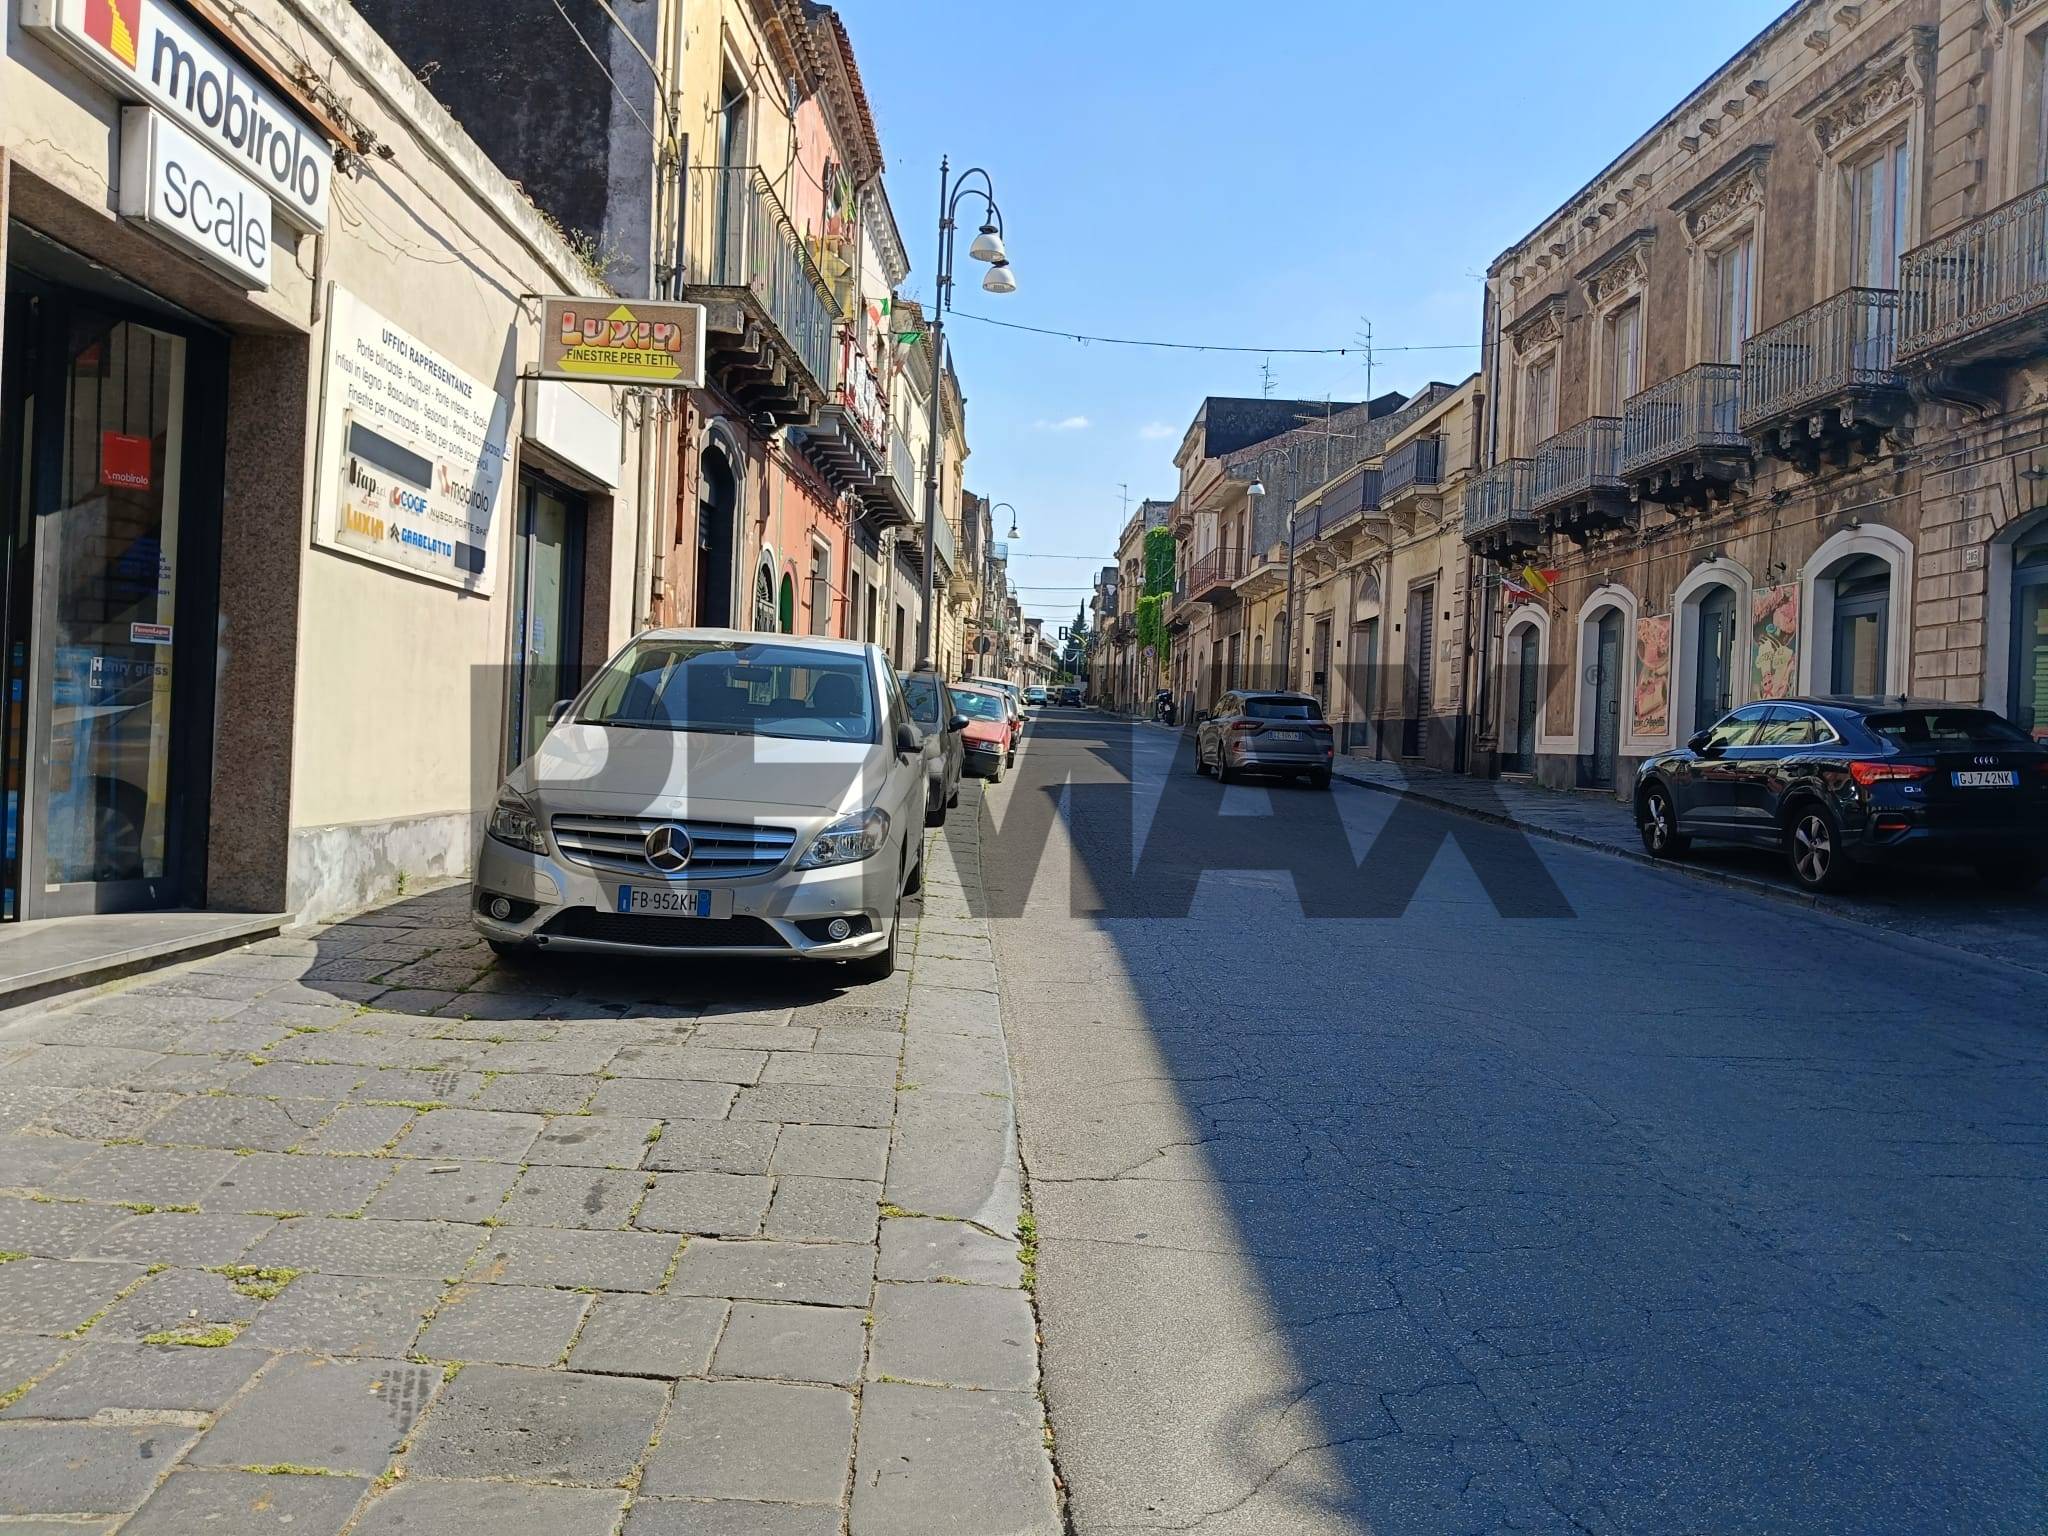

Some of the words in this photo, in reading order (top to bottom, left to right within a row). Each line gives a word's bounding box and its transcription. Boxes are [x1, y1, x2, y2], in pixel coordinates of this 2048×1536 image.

[152, 27, 320, 206] mobirolo
[164, 160, 267, 269] scale
[356, 338, 375, 362] Porte
[375, 349, 403, 379] blindate
[408, 370, 431, 396] Parquet
[435, 387, 450, 408] Porte
[382, 327, 408, 357] UFFICI
[409, 346, 473, 399] RAPPRESENTANZE
[566, 348, 618, 363] FINESTRE
[620, 352, 642, 365] PER
[645, 353, 674, 366] TETTI
[335, 349, 354, 374] Infissi
[354, 361, 361, 379] in
[362, 366, 383, 390] legno
[387, 381, 419, 412] Basculanti
[453, 419, 467, 439] Porte
[472, 433, 501, 458] scoparsa
[348, 383, 374, 410] Finestre
[375, 401, 387, 418] per
[387, 408, 420, 435] mansarde
[464, 450, 488, 471] scorevoli
[112, 472, 149, 485] mobirolo
[451, 480, 489, 512] mobirolo
